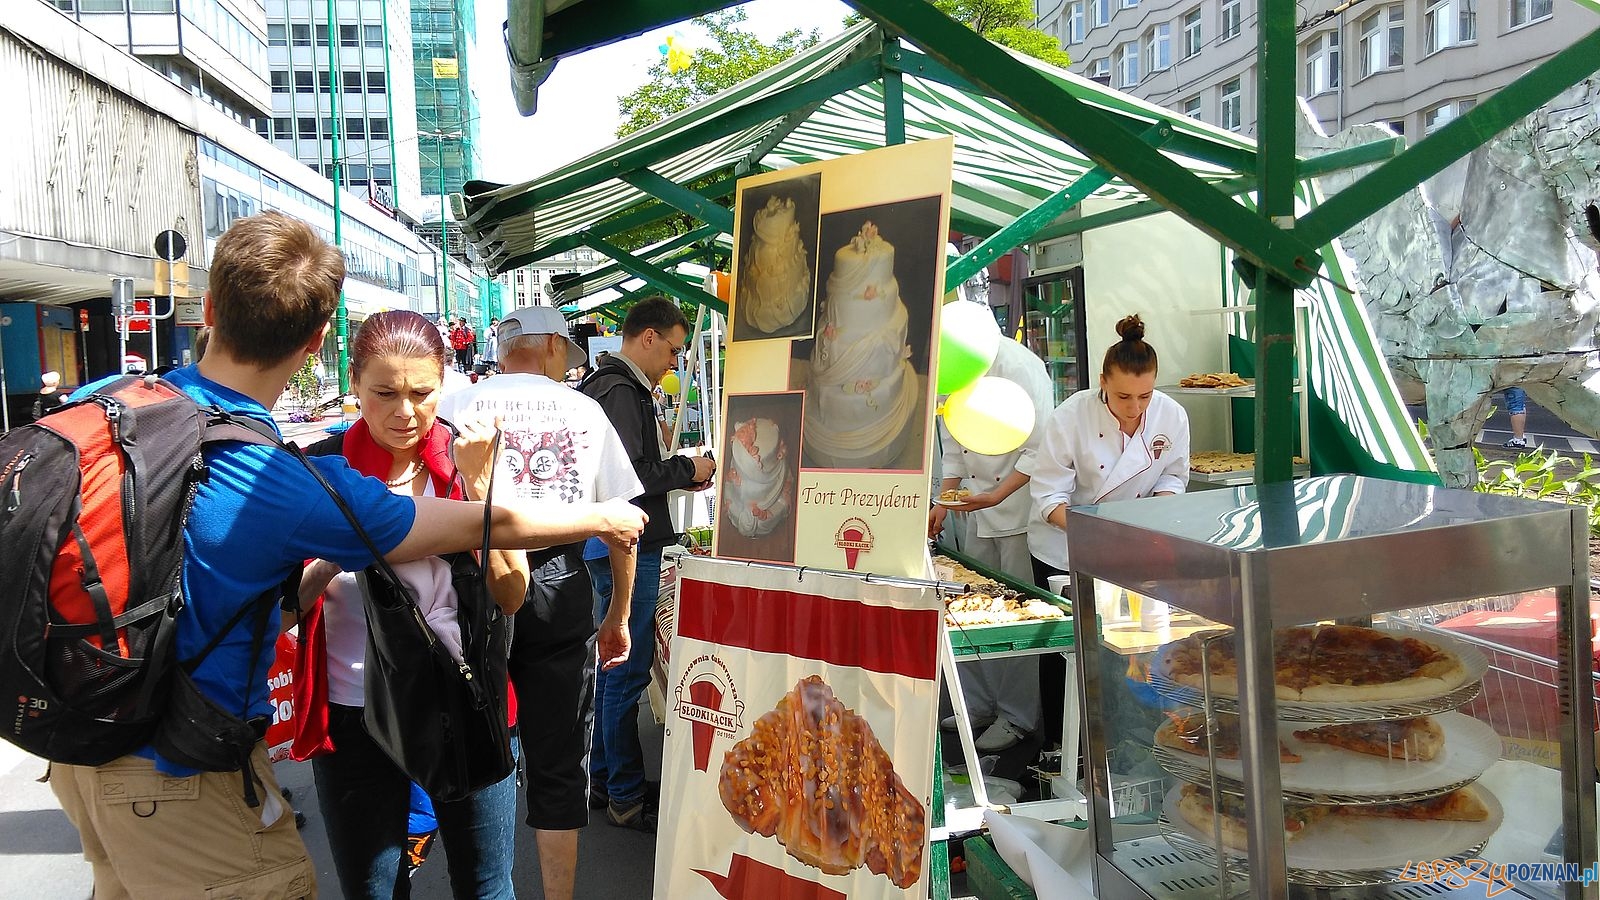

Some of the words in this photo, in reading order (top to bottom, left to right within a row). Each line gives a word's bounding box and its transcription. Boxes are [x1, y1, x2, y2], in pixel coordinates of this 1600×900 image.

[801, 482, 836, 505] Tort
[840, 485, 920, 517] Prezydent
[681, 705, 710, 722] SŁODKI
[709, 711, 734, 728] KĄCIK
